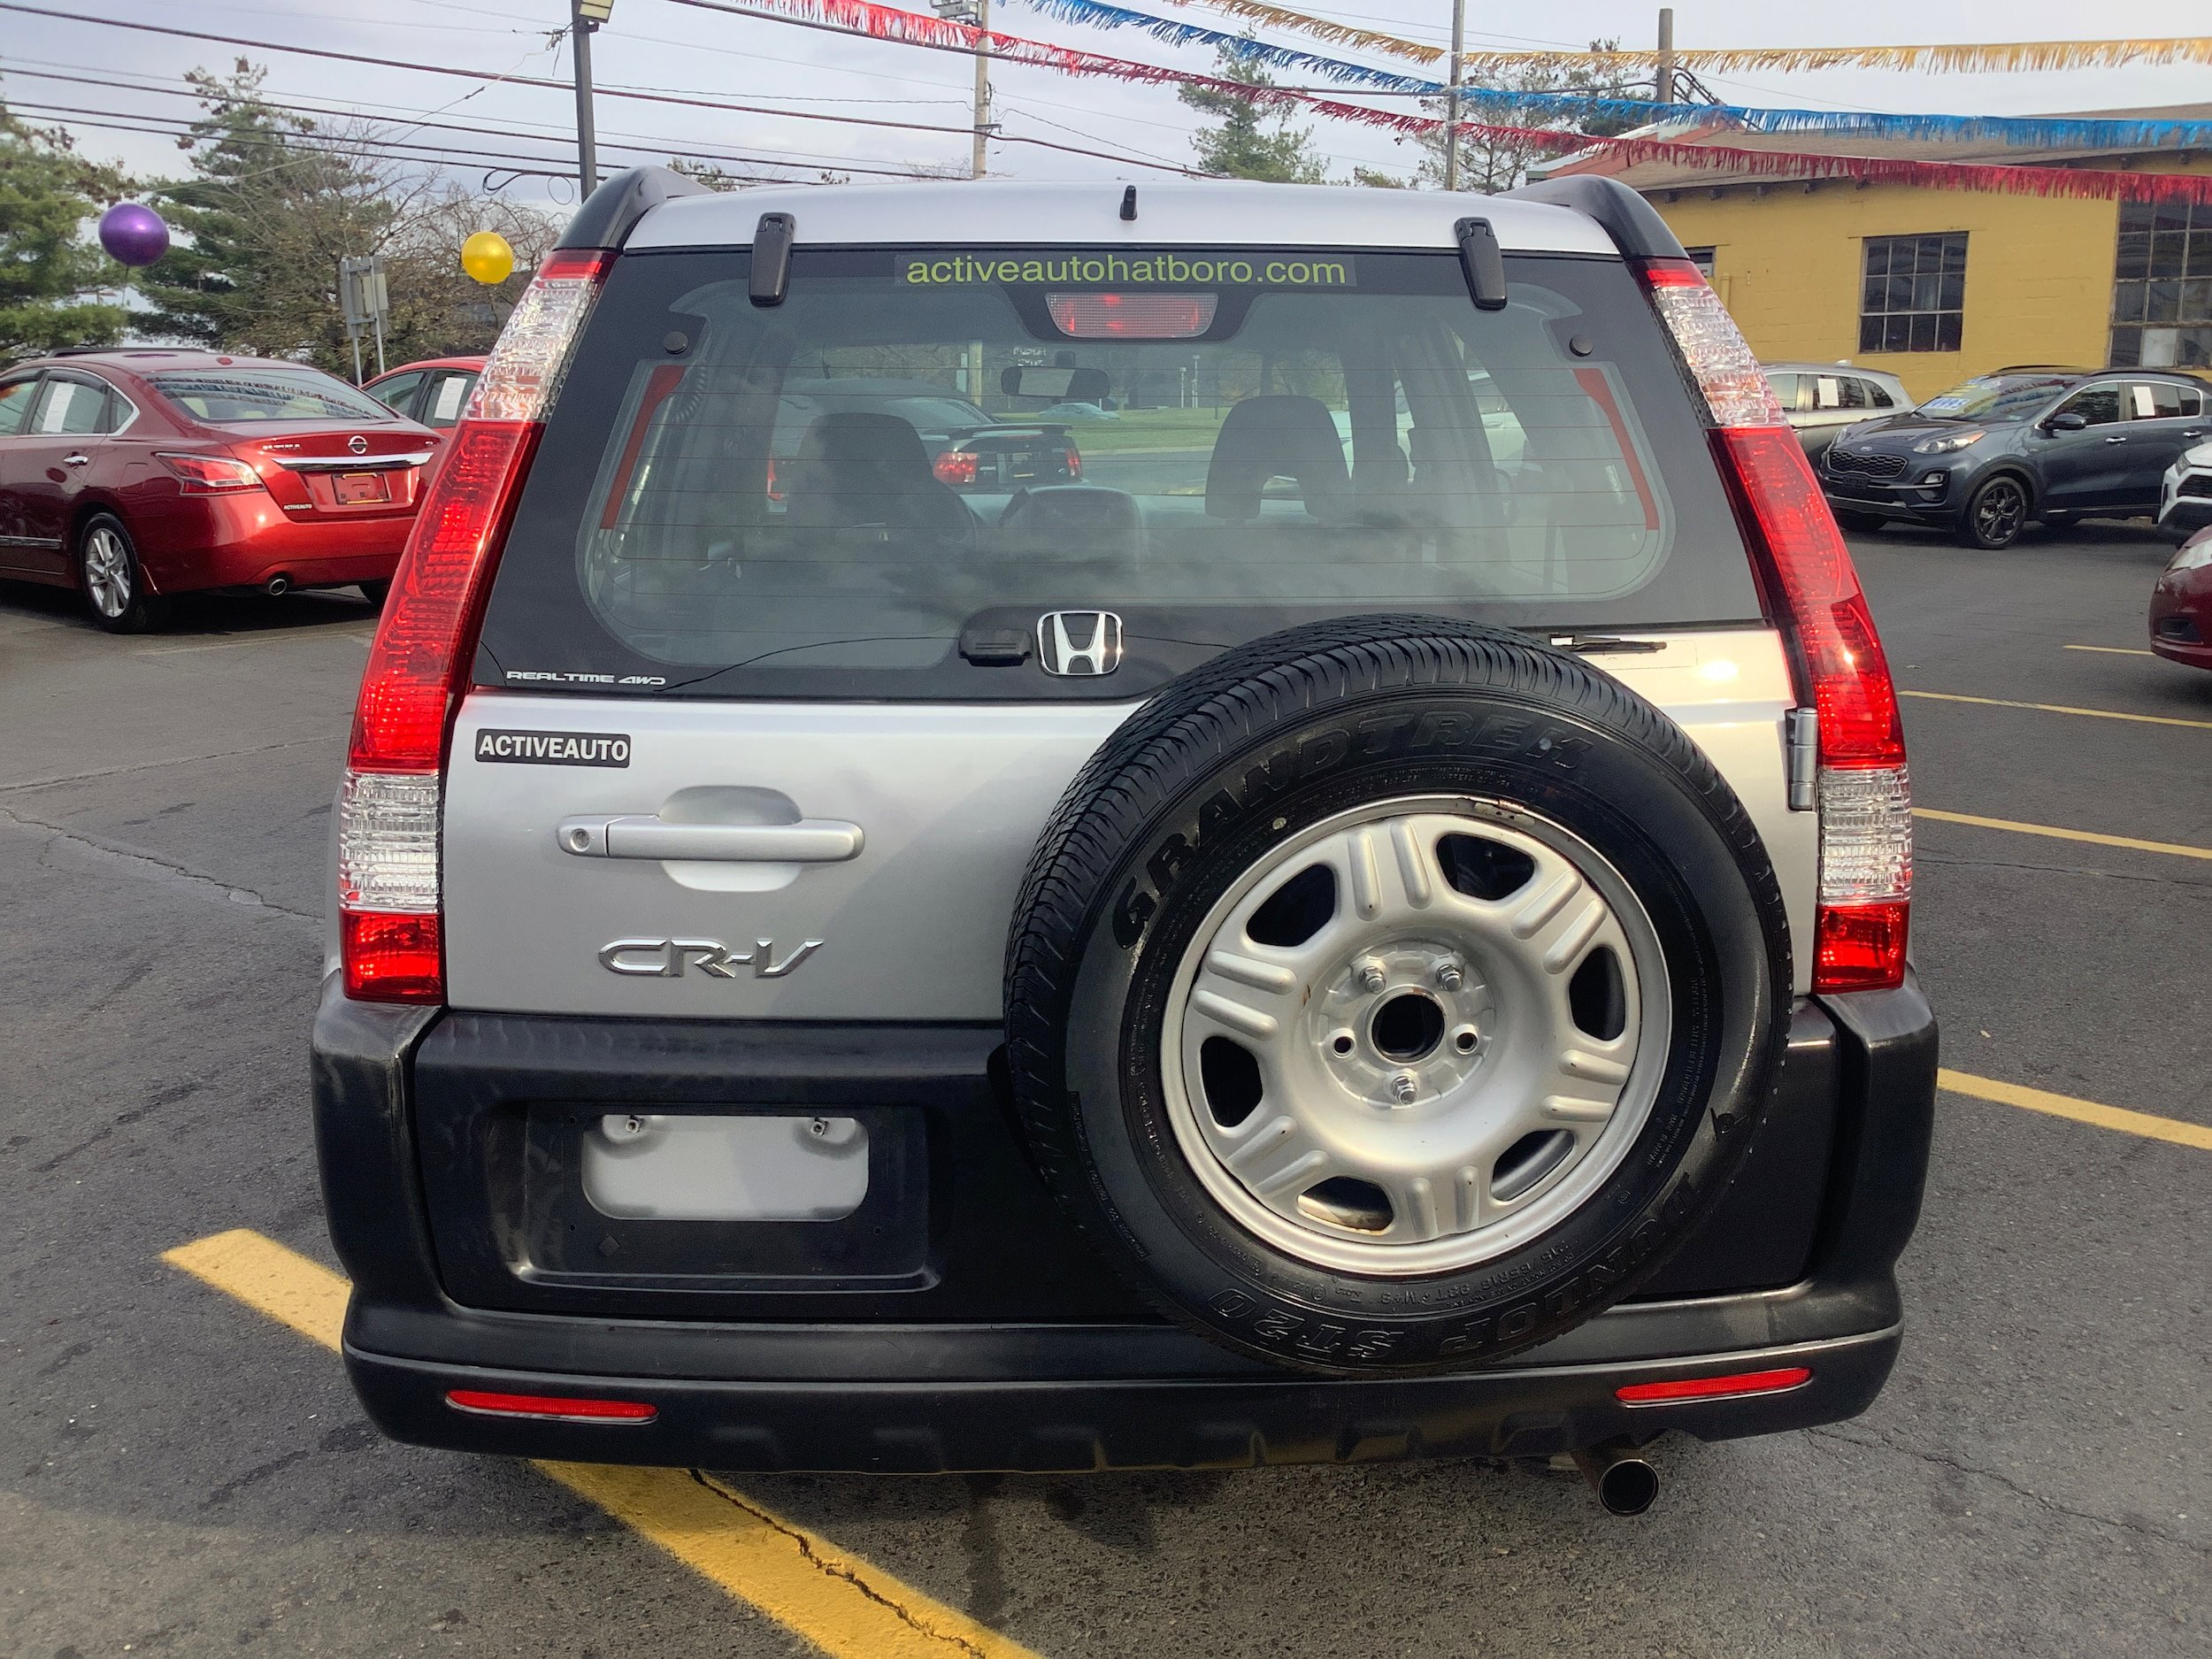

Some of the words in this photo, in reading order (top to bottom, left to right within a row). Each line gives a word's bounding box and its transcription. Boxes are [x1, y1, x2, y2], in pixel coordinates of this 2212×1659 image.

[907, 252, 1347, 286] activeautohatboro.com
[505, 671, 615, 684] REALTIME
[478, 734, 629, 762] ACTIVEAUTO
[1111, 709, 1595, 951] GRANDTREK
[598, 937, 825, 979] CR-V
[1439, 1175, 1699, 1356] DUNLOP
[1207, 1287, 1405, 1359] ST20
